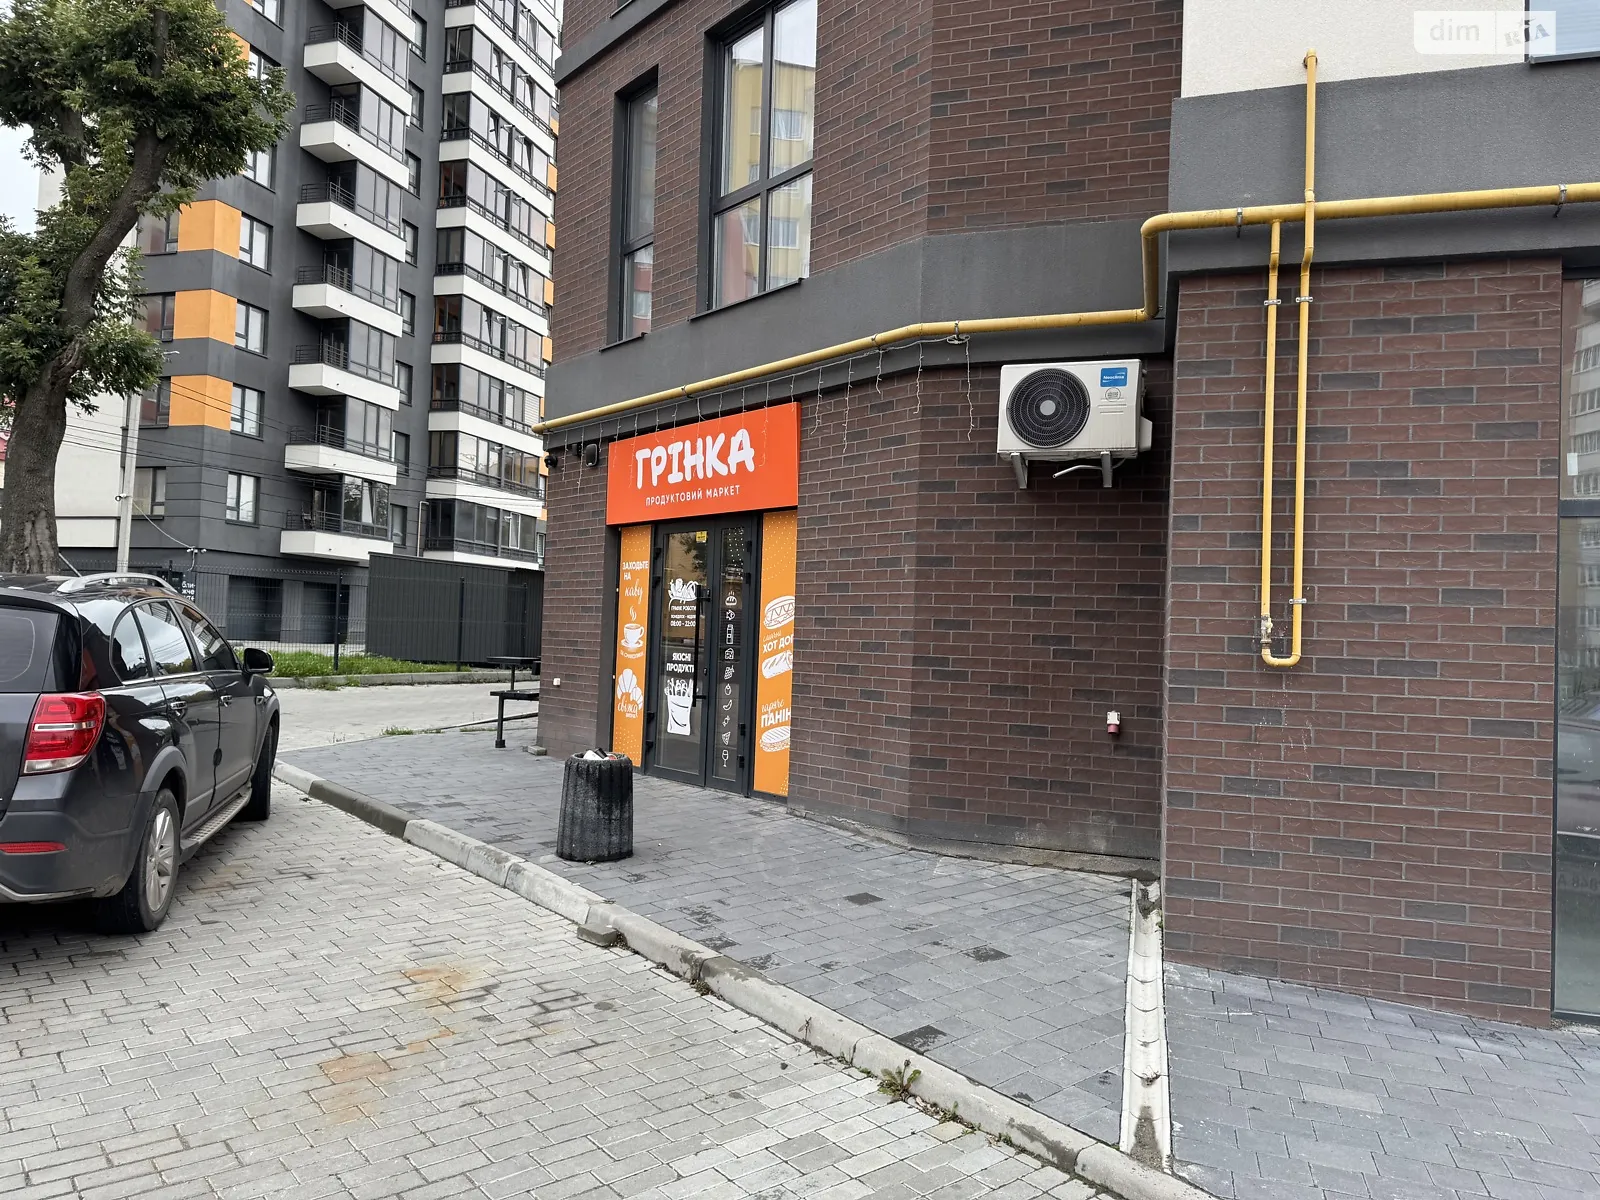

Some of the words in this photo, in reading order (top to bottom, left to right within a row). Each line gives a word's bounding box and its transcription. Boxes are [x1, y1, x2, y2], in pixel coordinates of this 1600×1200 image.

[635, 428, 755, 490] ГРІНКА
[645, 488, 703, 506] ПРОДУКТОВИЙ
[706, 485, 740, 498] МАРКЕТ
[623, 571, 632, 580] НА
[762, 639, 778, 654] ХОТ
